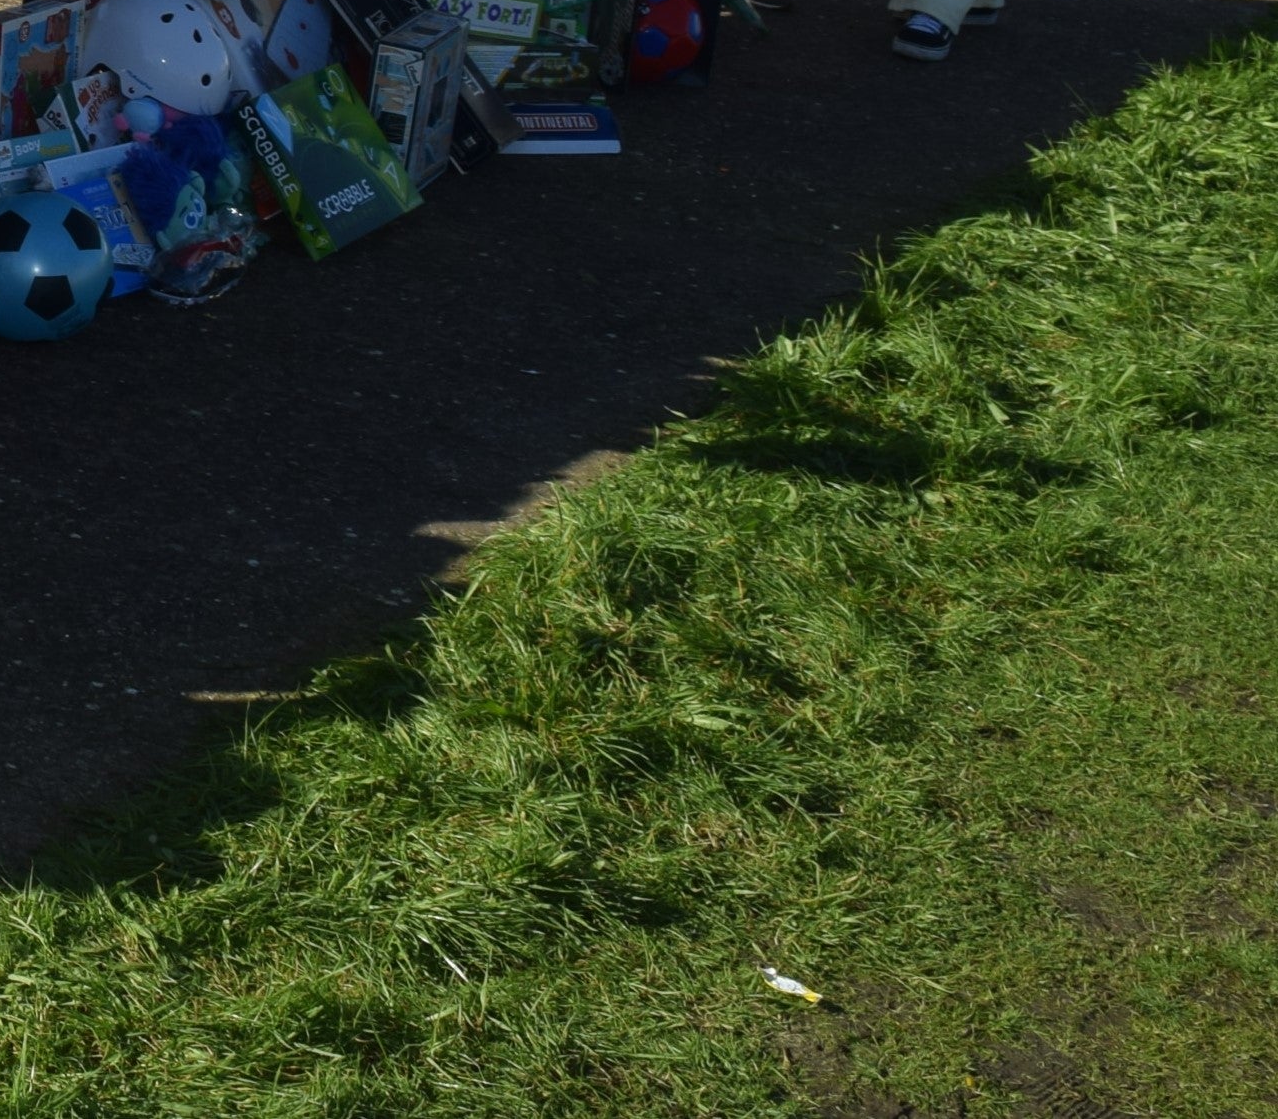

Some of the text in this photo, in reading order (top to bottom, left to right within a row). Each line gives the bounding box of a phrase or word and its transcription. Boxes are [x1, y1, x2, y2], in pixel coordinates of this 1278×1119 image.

[477, 0, 532, 27] FORTS!
[46, 109, 67, 131] Dise
[516, 114, 595, 130] ONTINENTAL
[15, 138, 41, 157] Baby
[239, 105, 299, 198] SCRABBLE
[318, 179, 376, 219] SCRABBLE
